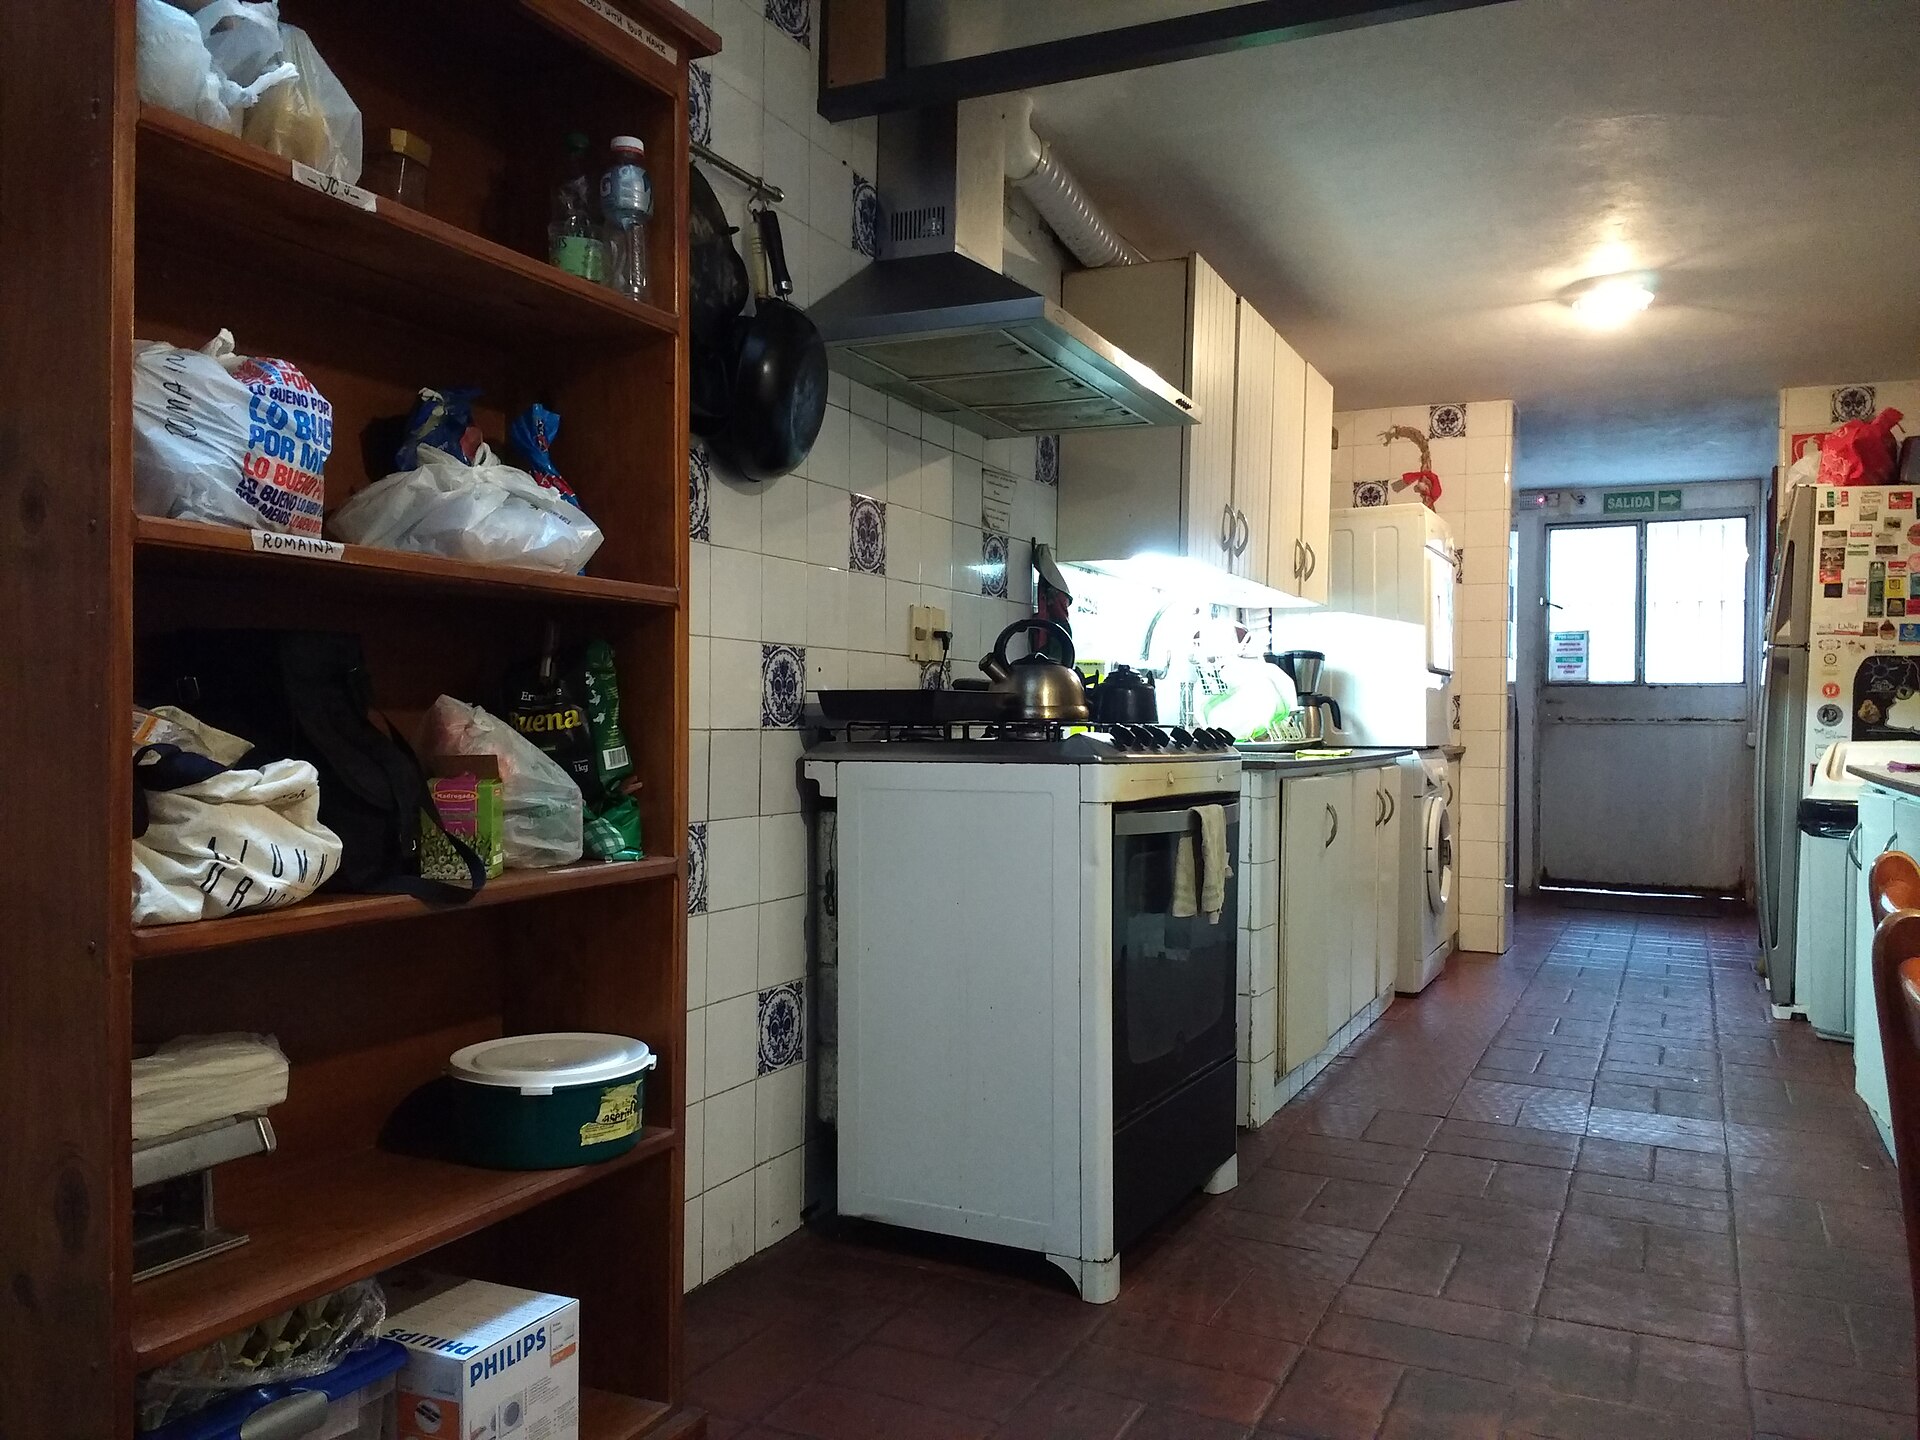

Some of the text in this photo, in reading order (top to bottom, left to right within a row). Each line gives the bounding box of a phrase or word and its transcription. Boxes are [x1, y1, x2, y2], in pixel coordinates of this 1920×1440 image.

[605, 7, 623, 26] WITH
[627, 21, 643, 39] YOUR
[646, 35, 666, 55] NAME
[249, 395, 289, 430] LO
[269, 387, 308, 409] BUENO
[310, 397, 331, 416] POR
[248, 424, 296, 463] POR
[243, 452, 270, 479] LO
[260, 485, 298, 511] BUENO
[1607, 496, 1651, 510] SALIDA
[258, 503, 292, 526] MENOS
[262, 533, 334, 554] ROMAINA
[511, 709, 582, 733] Buena
[382, 1328, 480, 1356] PHILIPS
[470, 1326, 547, 1388] PHILIPS
